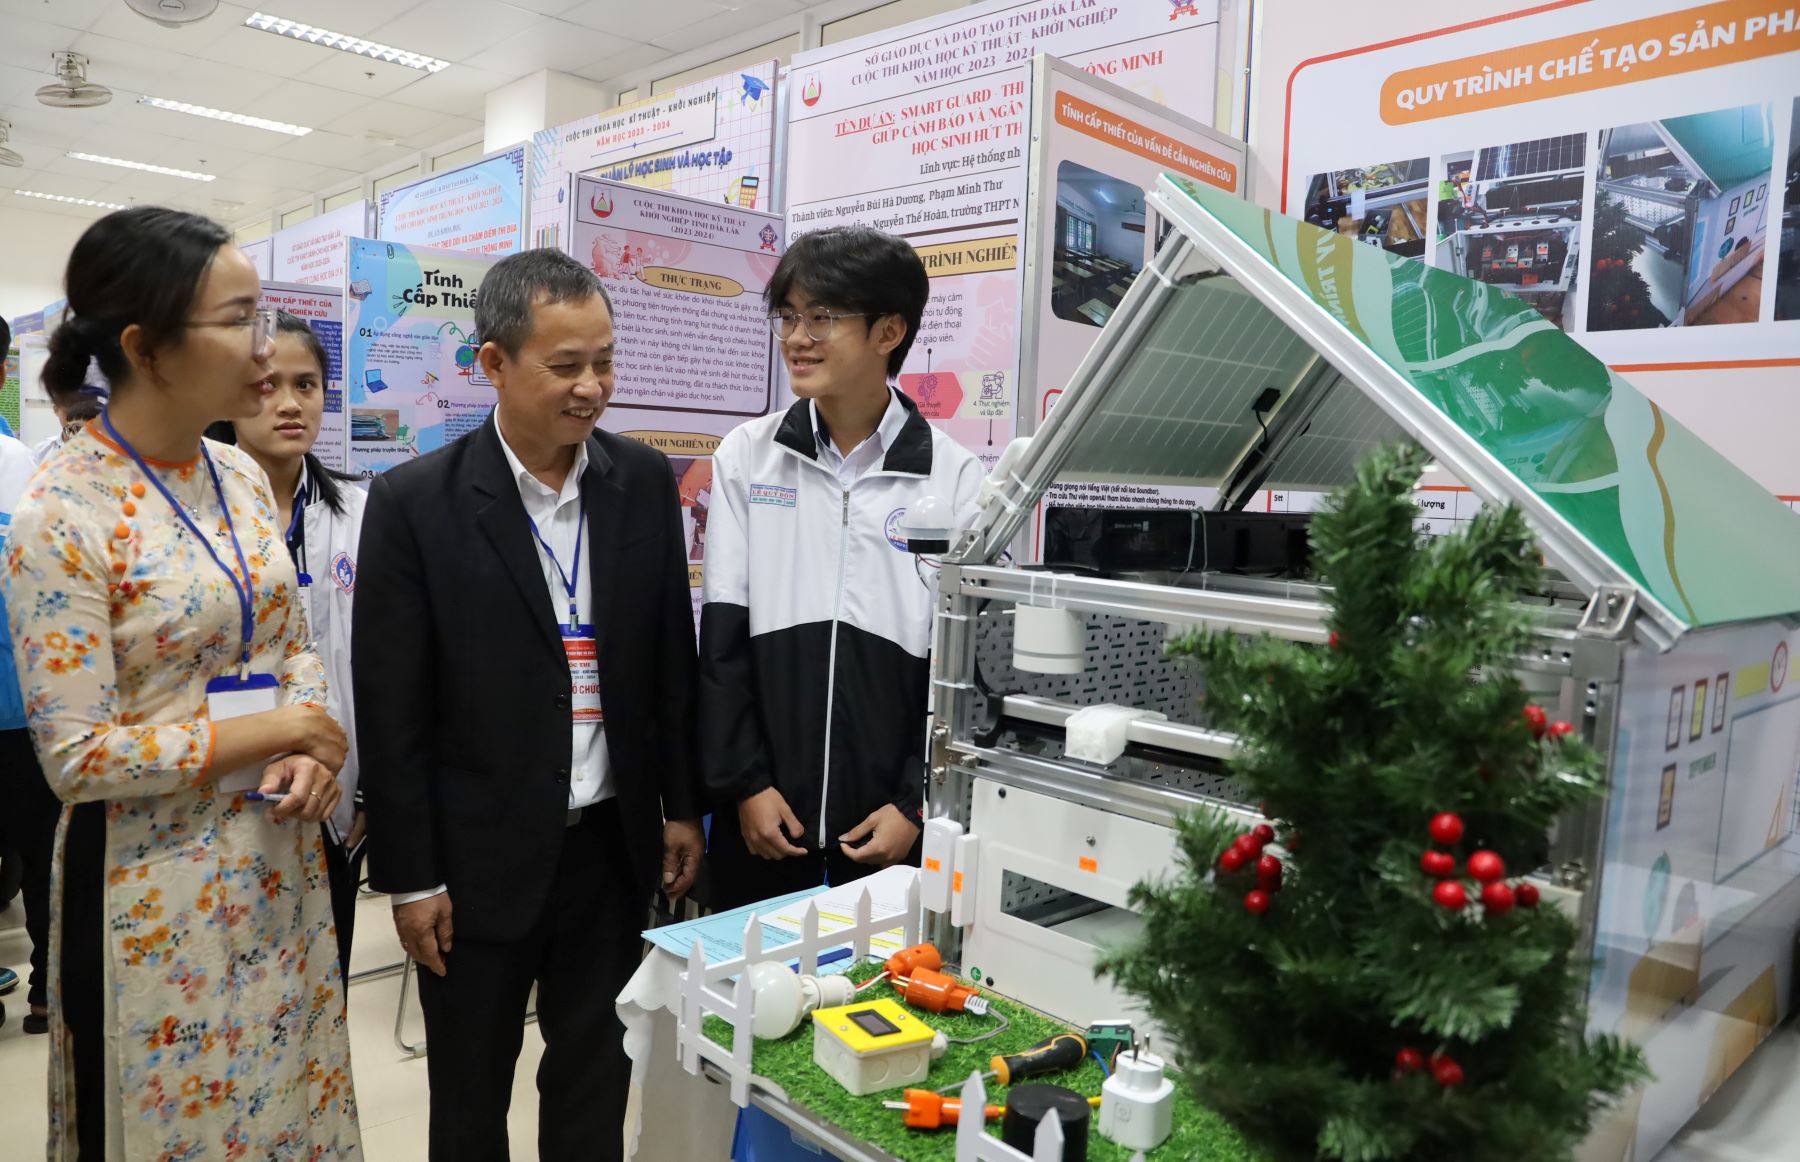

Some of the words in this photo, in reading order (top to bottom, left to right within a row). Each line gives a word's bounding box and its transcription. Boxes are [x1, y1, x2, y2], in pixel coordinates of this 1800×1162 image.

[852, 68, 880, 86] CUỘC
[882, 63, 900, 78] THI
[902, 55, 934, 73] KHOA
[936, 47, 960, 65] HỌC
[980, 31, 1022, 53] THUẬT
[1032, 20, 1064, 40] KHỞI
[1068, 6, 1118, 31] NGHIỆP
[864, 51, 878, 67] SỞ
[882, 45, 907, 63] GIÁO
[910, 39, 932, 55] DỤC
[934, 31, 950, 48] VÀ
[952, 26, 977, 43] ĐÀO
[980, 19, 1004, 36] TẠO
[1008, 11, 1036, 29] TỈNH
[914, 70, 938, 85] NĂM
[940, 63, 964, 79] HỌC
[968, 56, 996, 72] 2023
[1006, 46, 1036, 63] 2024
[1082, 59, 1117, 76] ÔNG
[1122, 50, 1164, 72] MINH
[1396, 81, 1448, 111] QUY
[1453, 65, 1533, 98] TRÌNH
[1539, 38, 1600, 82] CHẾ
[1600, 39, 1663, 73] TẠO
[1668, 20, 1737, 56] SẢN
[1743, 8, 1800, 41] PH
[594, 122, 610, 134] KHOA
[638, 107, 660, 122] THUẬT
[688, 90, 716, 107] NGHIỆP
[836, 118, 856, 135] TÊN
[900, 99, 944, 120] SMART
[946, 88, 992, 110] GUARD
[872, 126, 900, 146] GIÚP
[902, 119, 936, 139] CẢNH
[938, 112, 966, 131] BÁO
[968, 105, 986, 125] VÀ
[596, 135, 610, 147] NĂM
[912, 138, 938, 156] HỌC
[942, 131, 970, 149] SINH
[974, 123, 1004, 143] HÚT
[1004, 121, 1022, 137] TH
[1062, 103, 1083, 124] TÍNH
[1084, 111, 1102, 131] CẤP
[1102, 121, 1126, 141] THIẾT
[1127, 130, 1144, 148] CỦA
[1144, 135, 1161, 155] VẤN
[1162, 142, 1173, 160] ĐỀ
[1188, 156, 1216, 177] NGHIÊN
[1217, 167, 1232, 183] CỨU
[624, 161, 634, 180] LÝ
[635, 160, 654, 180] HỌC
[654, 156, 676, 173] SINH
[678, 150, 690, 169] VÀ
[692, 151, 712, 170] HỌC
[712, 146, 733, 167] TẬP
[920, 161, 940, 174] Lĩnh
[962, 154, 975, 169] Hệ
[978, 149, 1006, 165] thống
[1008, 146, 1020, 159] nh
[792, 210, 814, 223] Thành
[836, 201, 865, 217] Nguyễn
[866, 199, 880, 211] Bùi
[929, 189, 954, 201] Phạm
[956, 182, 982, 197] Minh
[984, 179, 1004, 192] Thư
[872, 214, 904, 232] Nguyễn
[906, 210, 922, 225] Thế
[924, 209, 950, 222] Hoàn,
[950, 204, 982, 218] trường
[984, 198, 1011, 213] THPT
[662, 214, 690, 227] NGHIỆP
[920, 249, 962, 268] TRÌNH
[402, 283, 438, 308] Cấp
[424, 269, 463, 289] Tính
[660, 273, 688, 287] THỰC
[690, 277, 722, 290] TRẠNG
[359, 327, 373, 337] 01
[437, 400, 450, 409] 02
[1421, 498, 1446, 510] lượng
